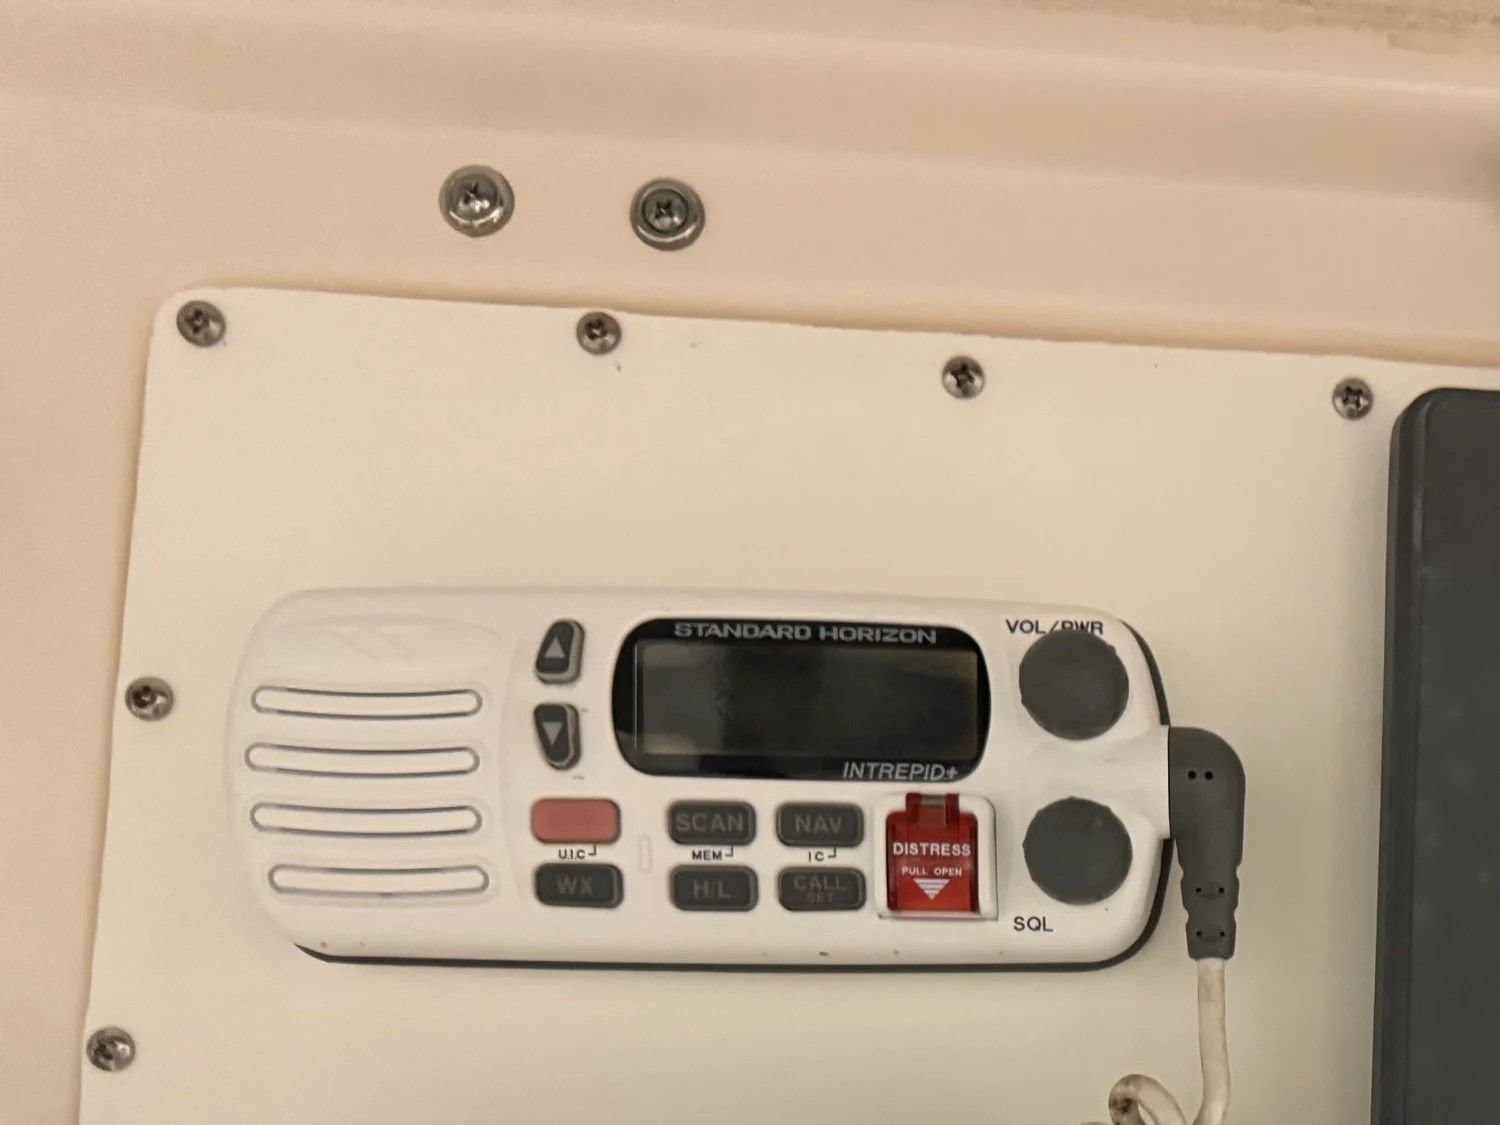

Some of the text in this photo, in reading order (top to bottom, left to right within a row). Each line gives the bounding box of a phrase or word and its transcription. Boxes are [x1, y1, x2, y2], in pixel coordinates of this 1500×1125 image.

[674, 622, 937, 644] STANDARD HORIZON
[843, 761, 958, 782] INTREPID+
[676, 813, 744, 833] SCAN
[795, 815, 842, 834] NAV
[692, 849, 723, 861] MEM
[893, 842, 972, 857] DISTRESS
[901, 867, 963, 876] PULL OPEN
[557, 874, 594, 897] WX
[692, 878, 731, 899] H/L
[794, 875, 847, 891] CALL
[1013, 915, 1054, 932] SQL
